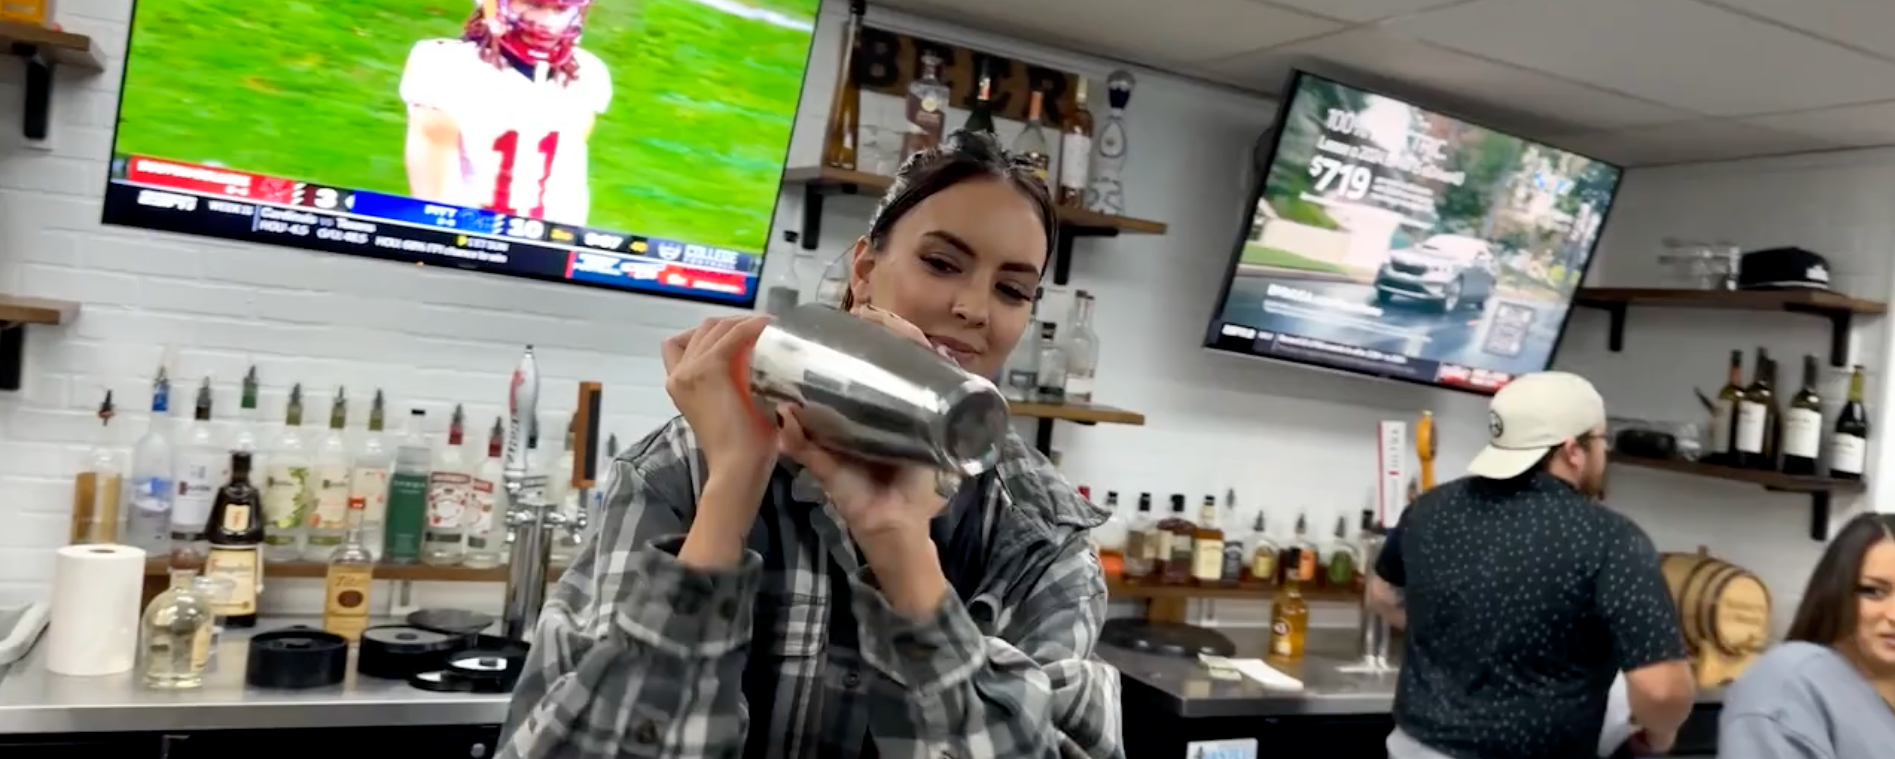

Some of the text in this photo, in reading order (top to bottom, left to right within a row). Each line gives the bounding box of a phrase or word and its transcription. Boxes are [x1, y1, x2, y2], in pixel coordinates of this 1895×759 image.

[857, 25, 1066, 125] BEER
[481, 130, 560, 219] 11
[1309, 154, 1371, 200] $719
[314, 188, 339, 209] 3
[507, 217, 545, 240] 10
[684, 243, 739, 263] COLLEGE
